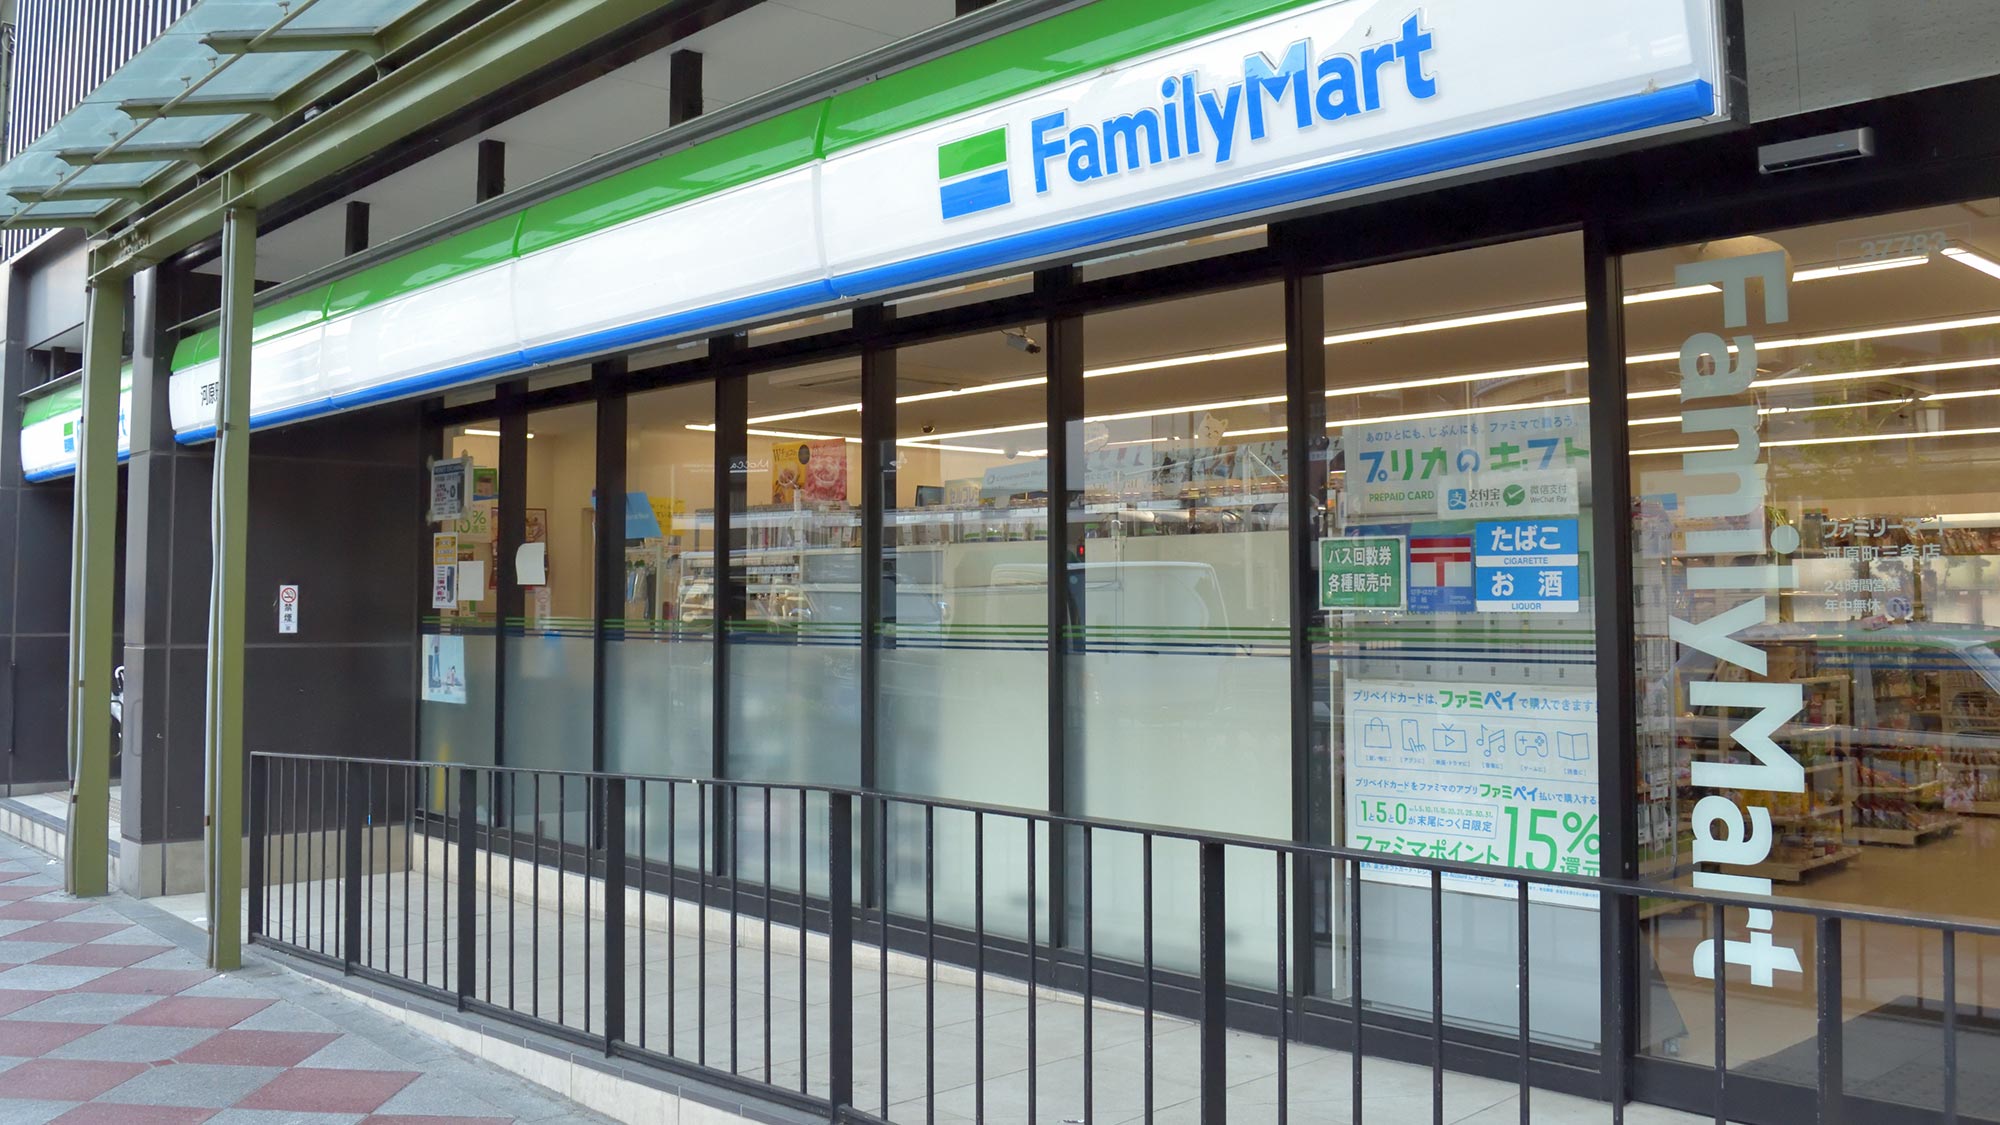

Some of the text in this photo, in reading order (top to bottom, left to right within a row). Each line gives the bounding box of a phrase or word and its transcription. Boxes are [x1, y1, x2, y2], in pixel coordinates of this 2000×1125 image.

[1031, 20, 1437, 194] FamilyMart
[1368, 490, 1434, 502] PREPAID CARD
[1468, 487, 1501, 501] 支付宝
[1821, 516, 1944, 539] ファミリーマート
[1490, 526, 1562, 552] たばこ
[1327, 546, 1393, 567] バス回数券
[1503, 556, 1549, 565] CIGARETTE
[1823, 543, 1942, 562] 河原町三条店
[1327, 573, 1393, 594] 各種販売中
[1511, 602, 1542, 611] LIQUOR
[1824, 599, 1882, 613] 年中無休
[1669, 249, 1805, 988] FamilyMart
